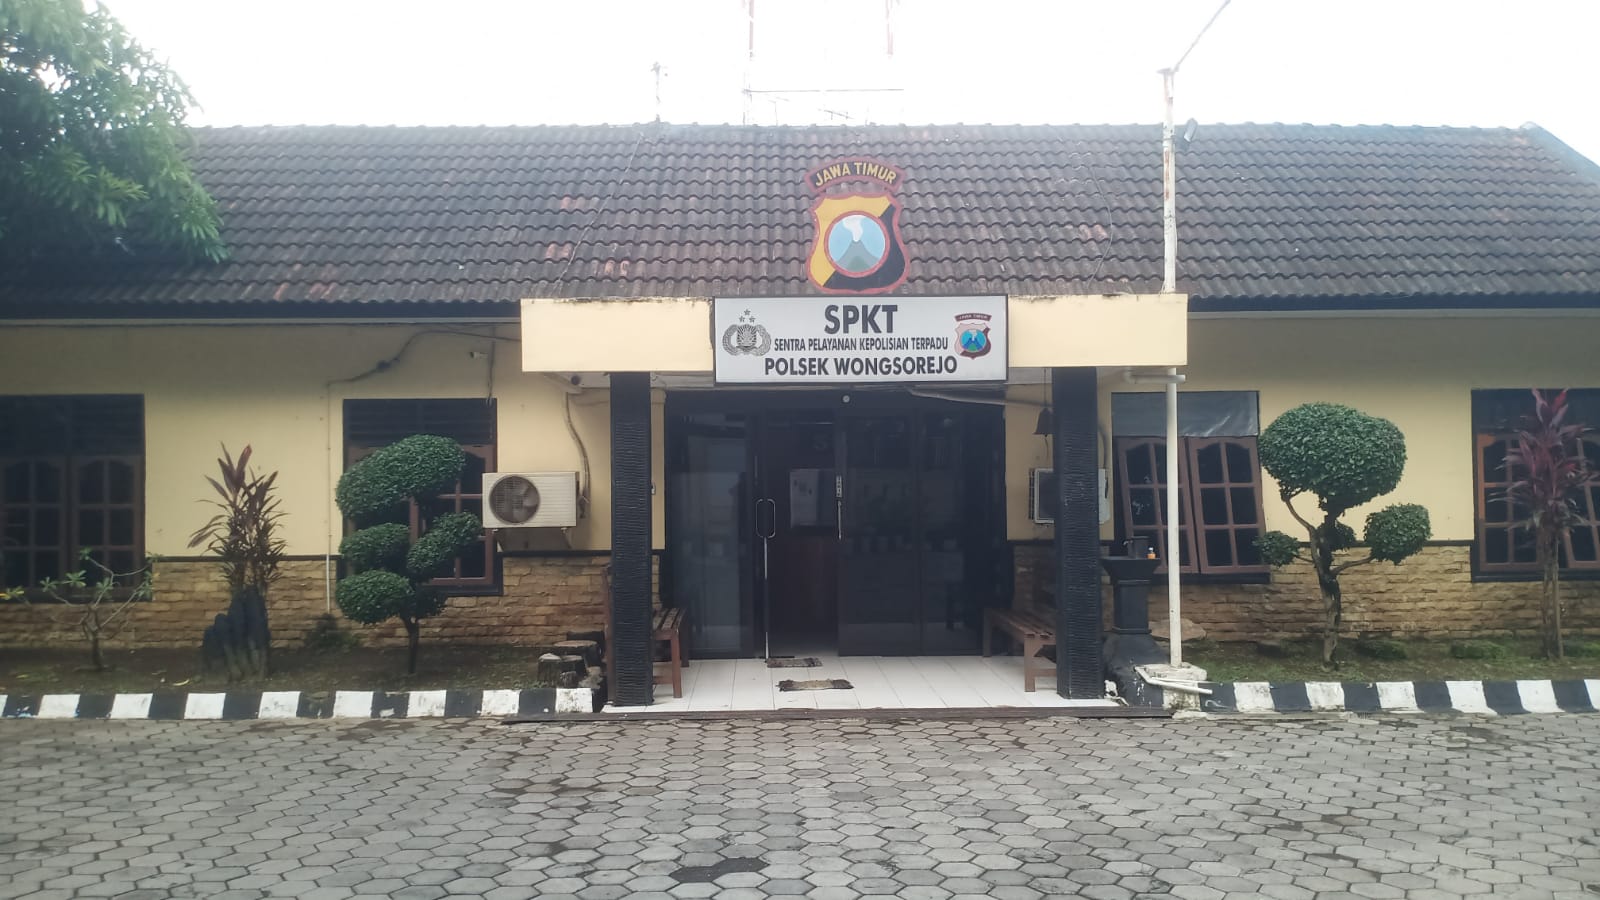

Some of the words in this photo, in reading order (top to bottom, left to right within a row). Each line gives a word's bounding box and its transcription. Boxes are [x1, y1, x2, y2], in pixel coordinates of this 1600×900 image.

[816, 163, 850, 186] JAWA
[854, 162, 896, 184] TIMUR
[824, 304, 898, 334] SPKT
[774, 338, 806, 351] SENTRA
[808, 338, 857, 351] PELAYANAN
[859, 337, 909, 350] KEPOLISIAN
[911, 337, 948, 350] TERPADU
[765, 357, 829, 375] POLSEK
[834, 355, 957, 375] WONGSOREJO
